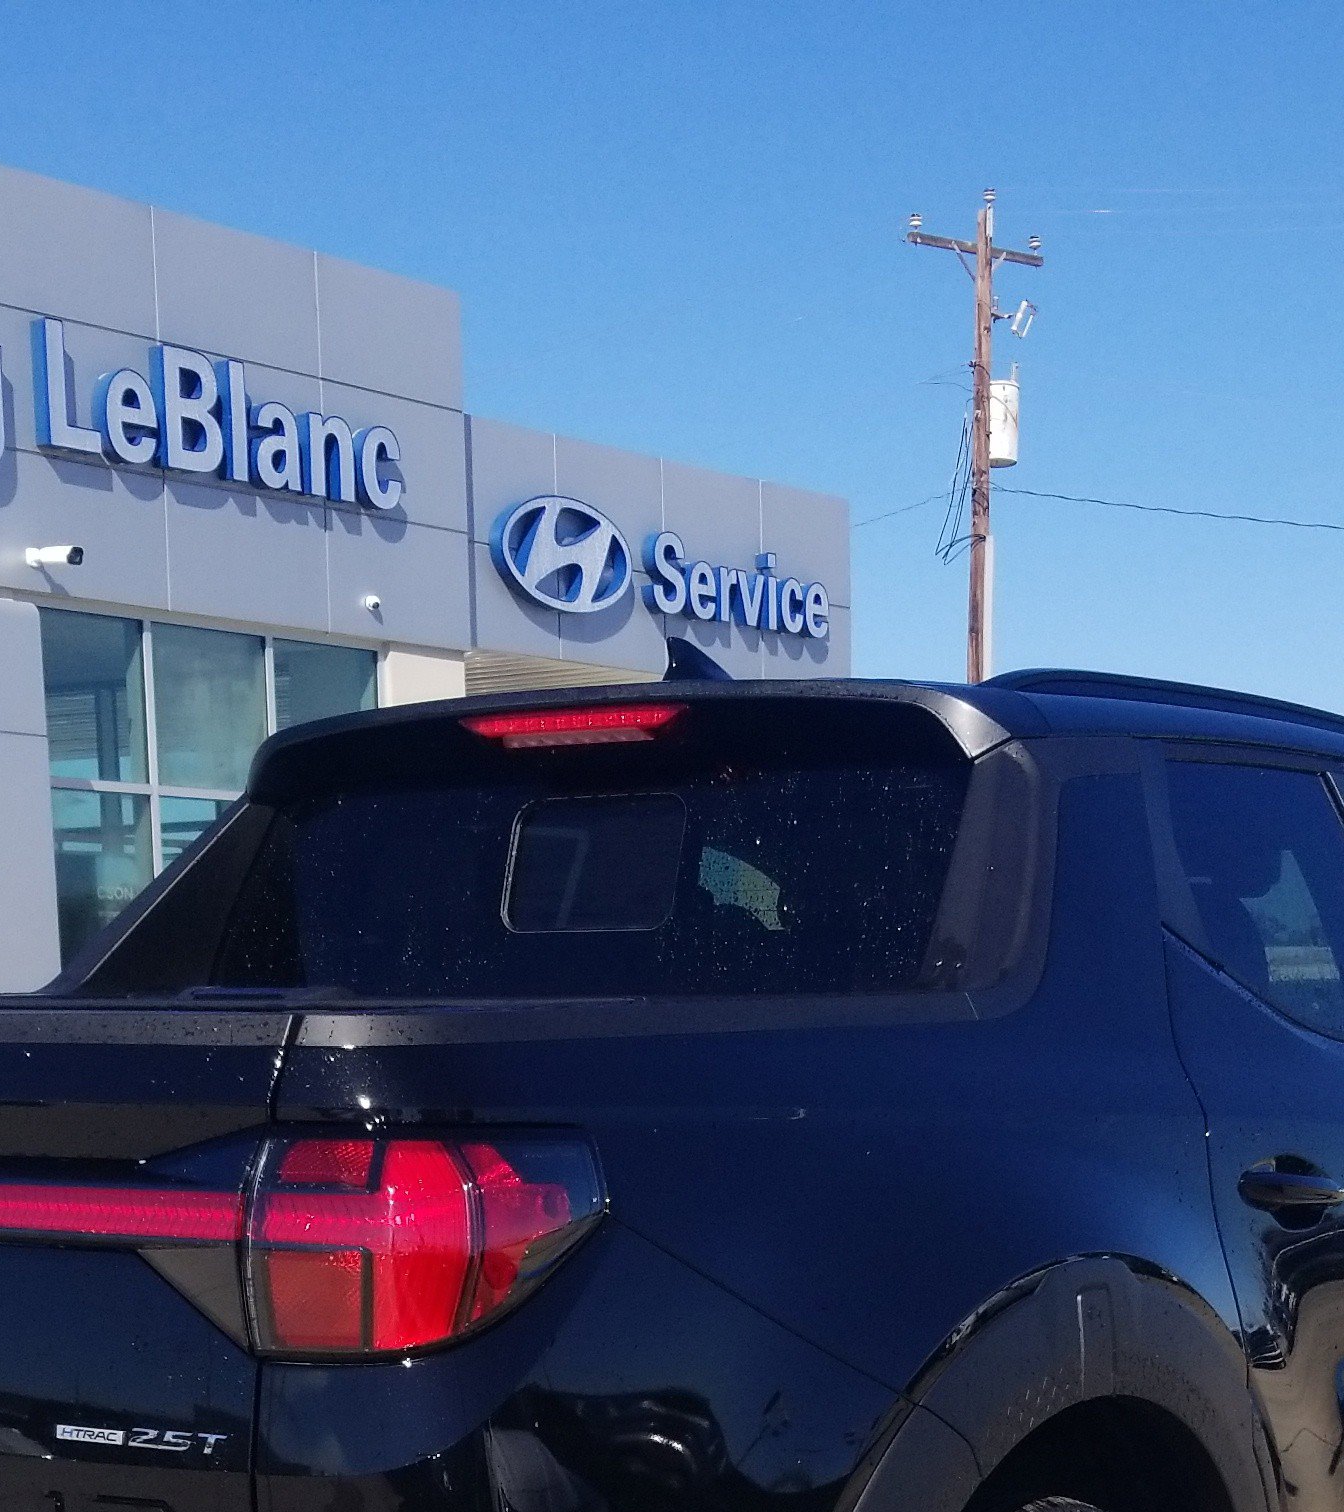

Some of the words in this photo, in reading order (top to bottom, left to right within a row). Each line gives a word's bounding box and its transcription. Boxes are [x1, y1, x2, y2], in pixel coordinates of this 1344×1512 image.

[30, 317, 402, 511] LeBlanc
[642, 531, 829, 639] Service
[60, 1426, 118, 1442] HTRAC
